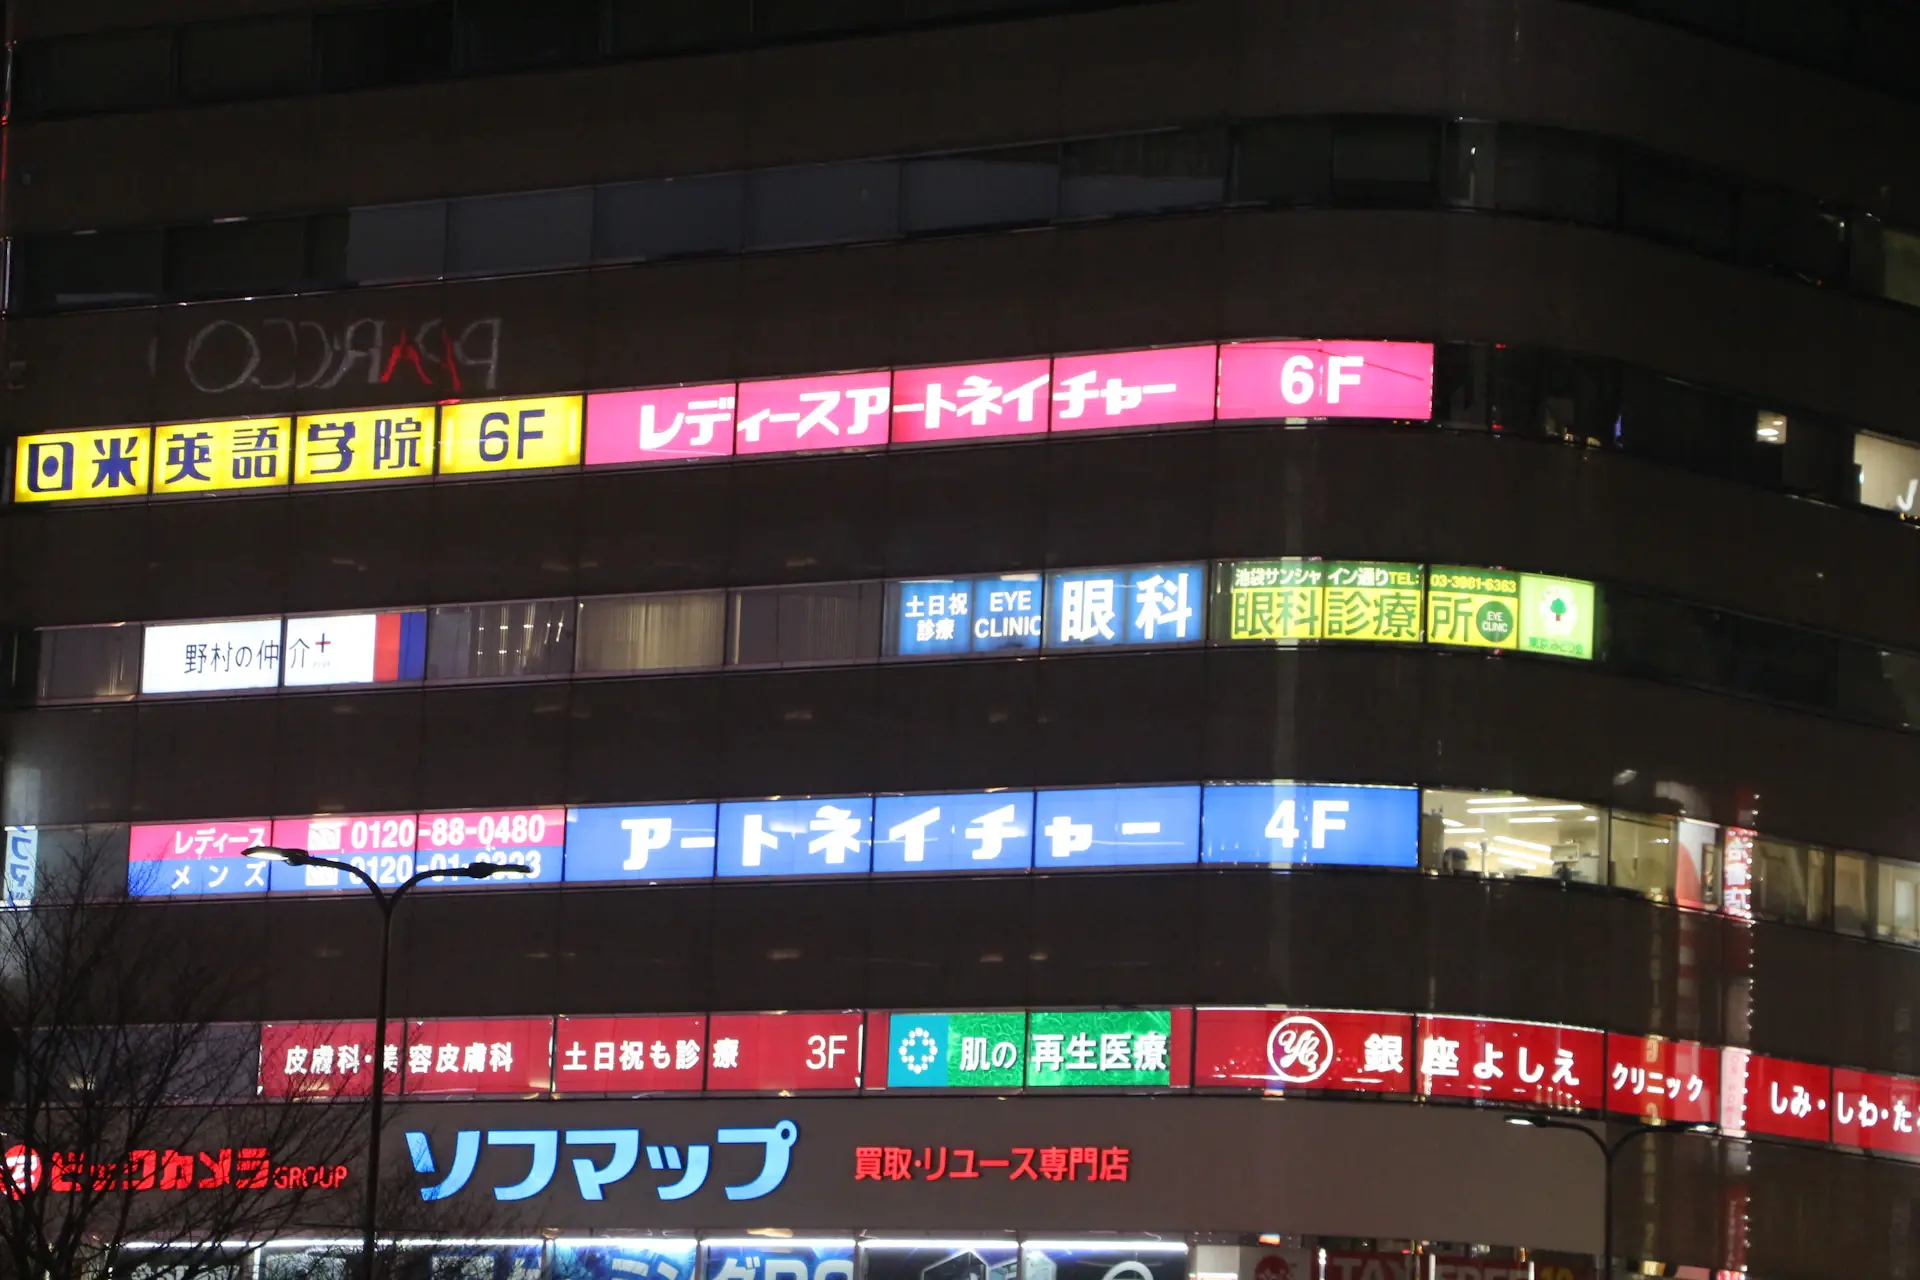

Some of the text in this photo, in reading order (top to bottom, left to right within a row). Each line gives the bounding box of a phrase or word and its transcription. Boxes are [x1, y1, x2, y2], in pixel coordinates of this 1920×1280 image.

[639, 355, 1365, 450] レディースアートネイチャー 6F
[27, 410, 545, 493] 日米英語学院 6F
[1235, 567, 1389, 587] 池袋サンシャイン通り
[904, 593, 968, 617] 土日祝
[989, 590, 1032, 613] EYE
[1060, 573, 1193, 643] 眼科
[1234, 589, 1473, 643] 眼科診療所
[1487, 611, 1504, 621] EYE
[916, 619, 955, 642] 診療
[974, 616, 1041, 639] CLINIC
[1482, 620, 1509, 634] CLINIC
[174, 828, 265, 855] レディース
[350, 814, 545, 849] 0120-88-0480
[621, 800, 1349, 870] アートネイチャー 4F
[171, 861, 265, 889] メンズ
[563, 1037, 739, 1071] 土日祝も診療
[805, 1034, 847, 1070] 3F
[960, 1033, 1168, 1073] 肌の再生医療
[1363, 1032, 1580, 1086] 銀座よしえ
[1611, 1061, 1704, 1102] クリニック
[1770, 1081, 1920, 1133] しみ・しわ・た
[273, 1165, 348, 1189] GROUP
[405, 1119, 798, 1200] ソフマップ
[855, 1145, 1130, 1182] 買取・リユース専門店
